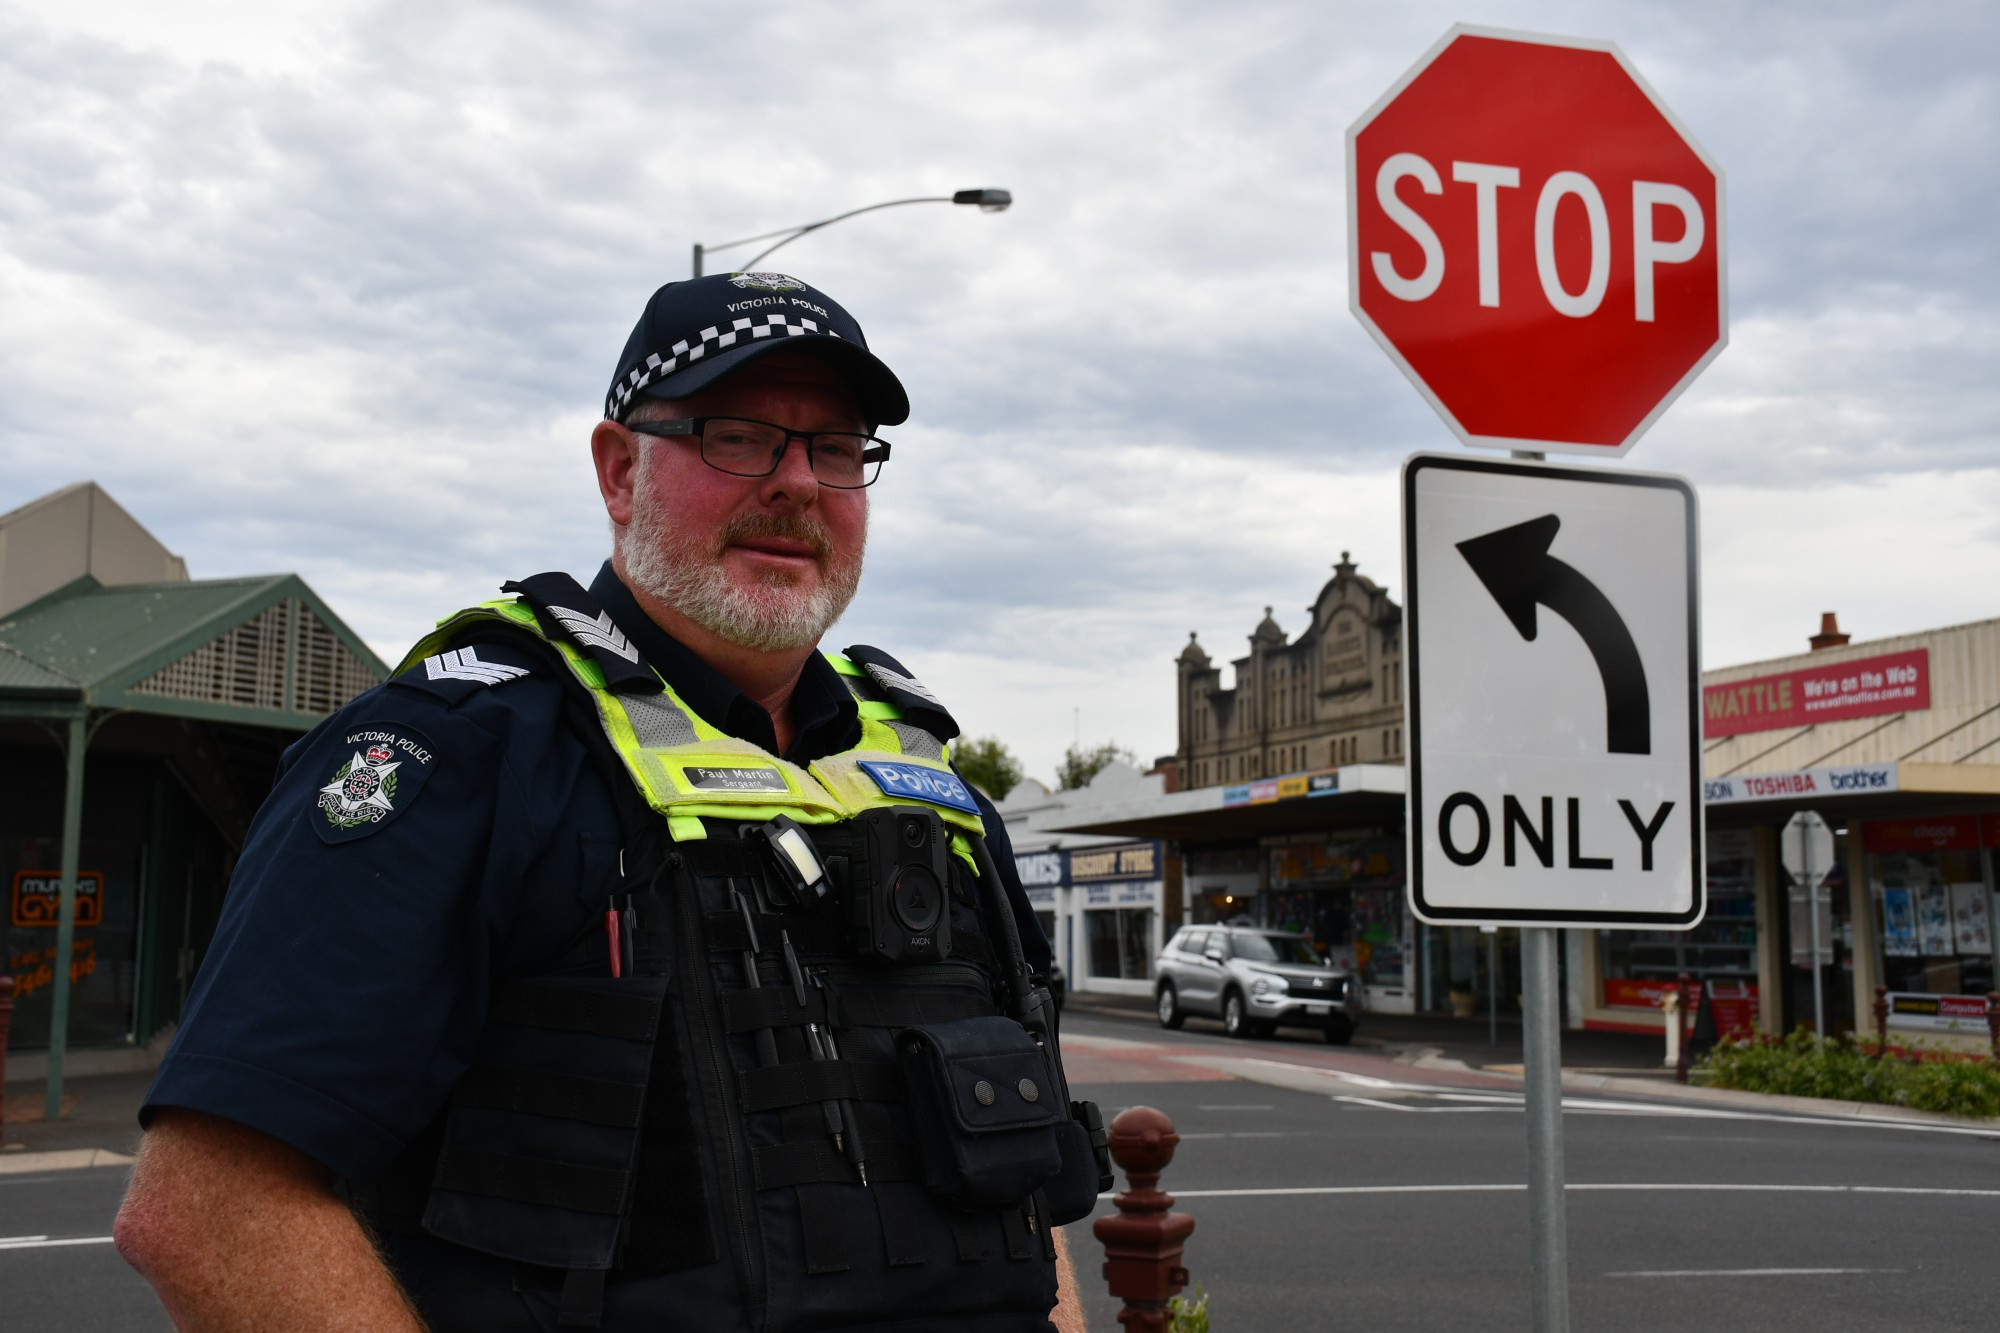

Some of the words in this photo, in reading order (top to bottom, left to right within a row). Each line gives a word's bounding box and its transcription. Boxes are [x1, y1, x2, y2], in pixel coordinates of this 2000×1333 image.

[1371, 152, 1705, 322] STOP
[727, 296, 787, 312] VICTORIA
[791, 298, 829, 319] POLICE
[1803, 678, 1837, 698] We're
[1841, 676, 1858, 693] on
[1860, 671, 1883, 689] the
[1886, 664, 1918, 686] Web
[1705, 678, 1794, 720] WATTLE
[346, 731, 396, 744] VICTORIA
[396, 738, 432, 765] POLICE
[348, 767, 379, 787] VICTORIA
[698, 768, 728, 779] Paul
[732, 769, 774, 779] Martin
[722, 779, 763, 788] Sergeant
[876, 767, 966, 801] Police
[1744, 773, 1816, 797] TOSHIBA
[1829, 769, 1888, 790] brother
[322, 793, 341, 813] UPHOLD
[341, 810, 355, 818] THE
[357, 807, 383, 817] RIGHT
[343, 787, 369, 801] POLICE
[1438, 791, 1676, 872] ONLY
[911, 937, 930, 945] AXON
